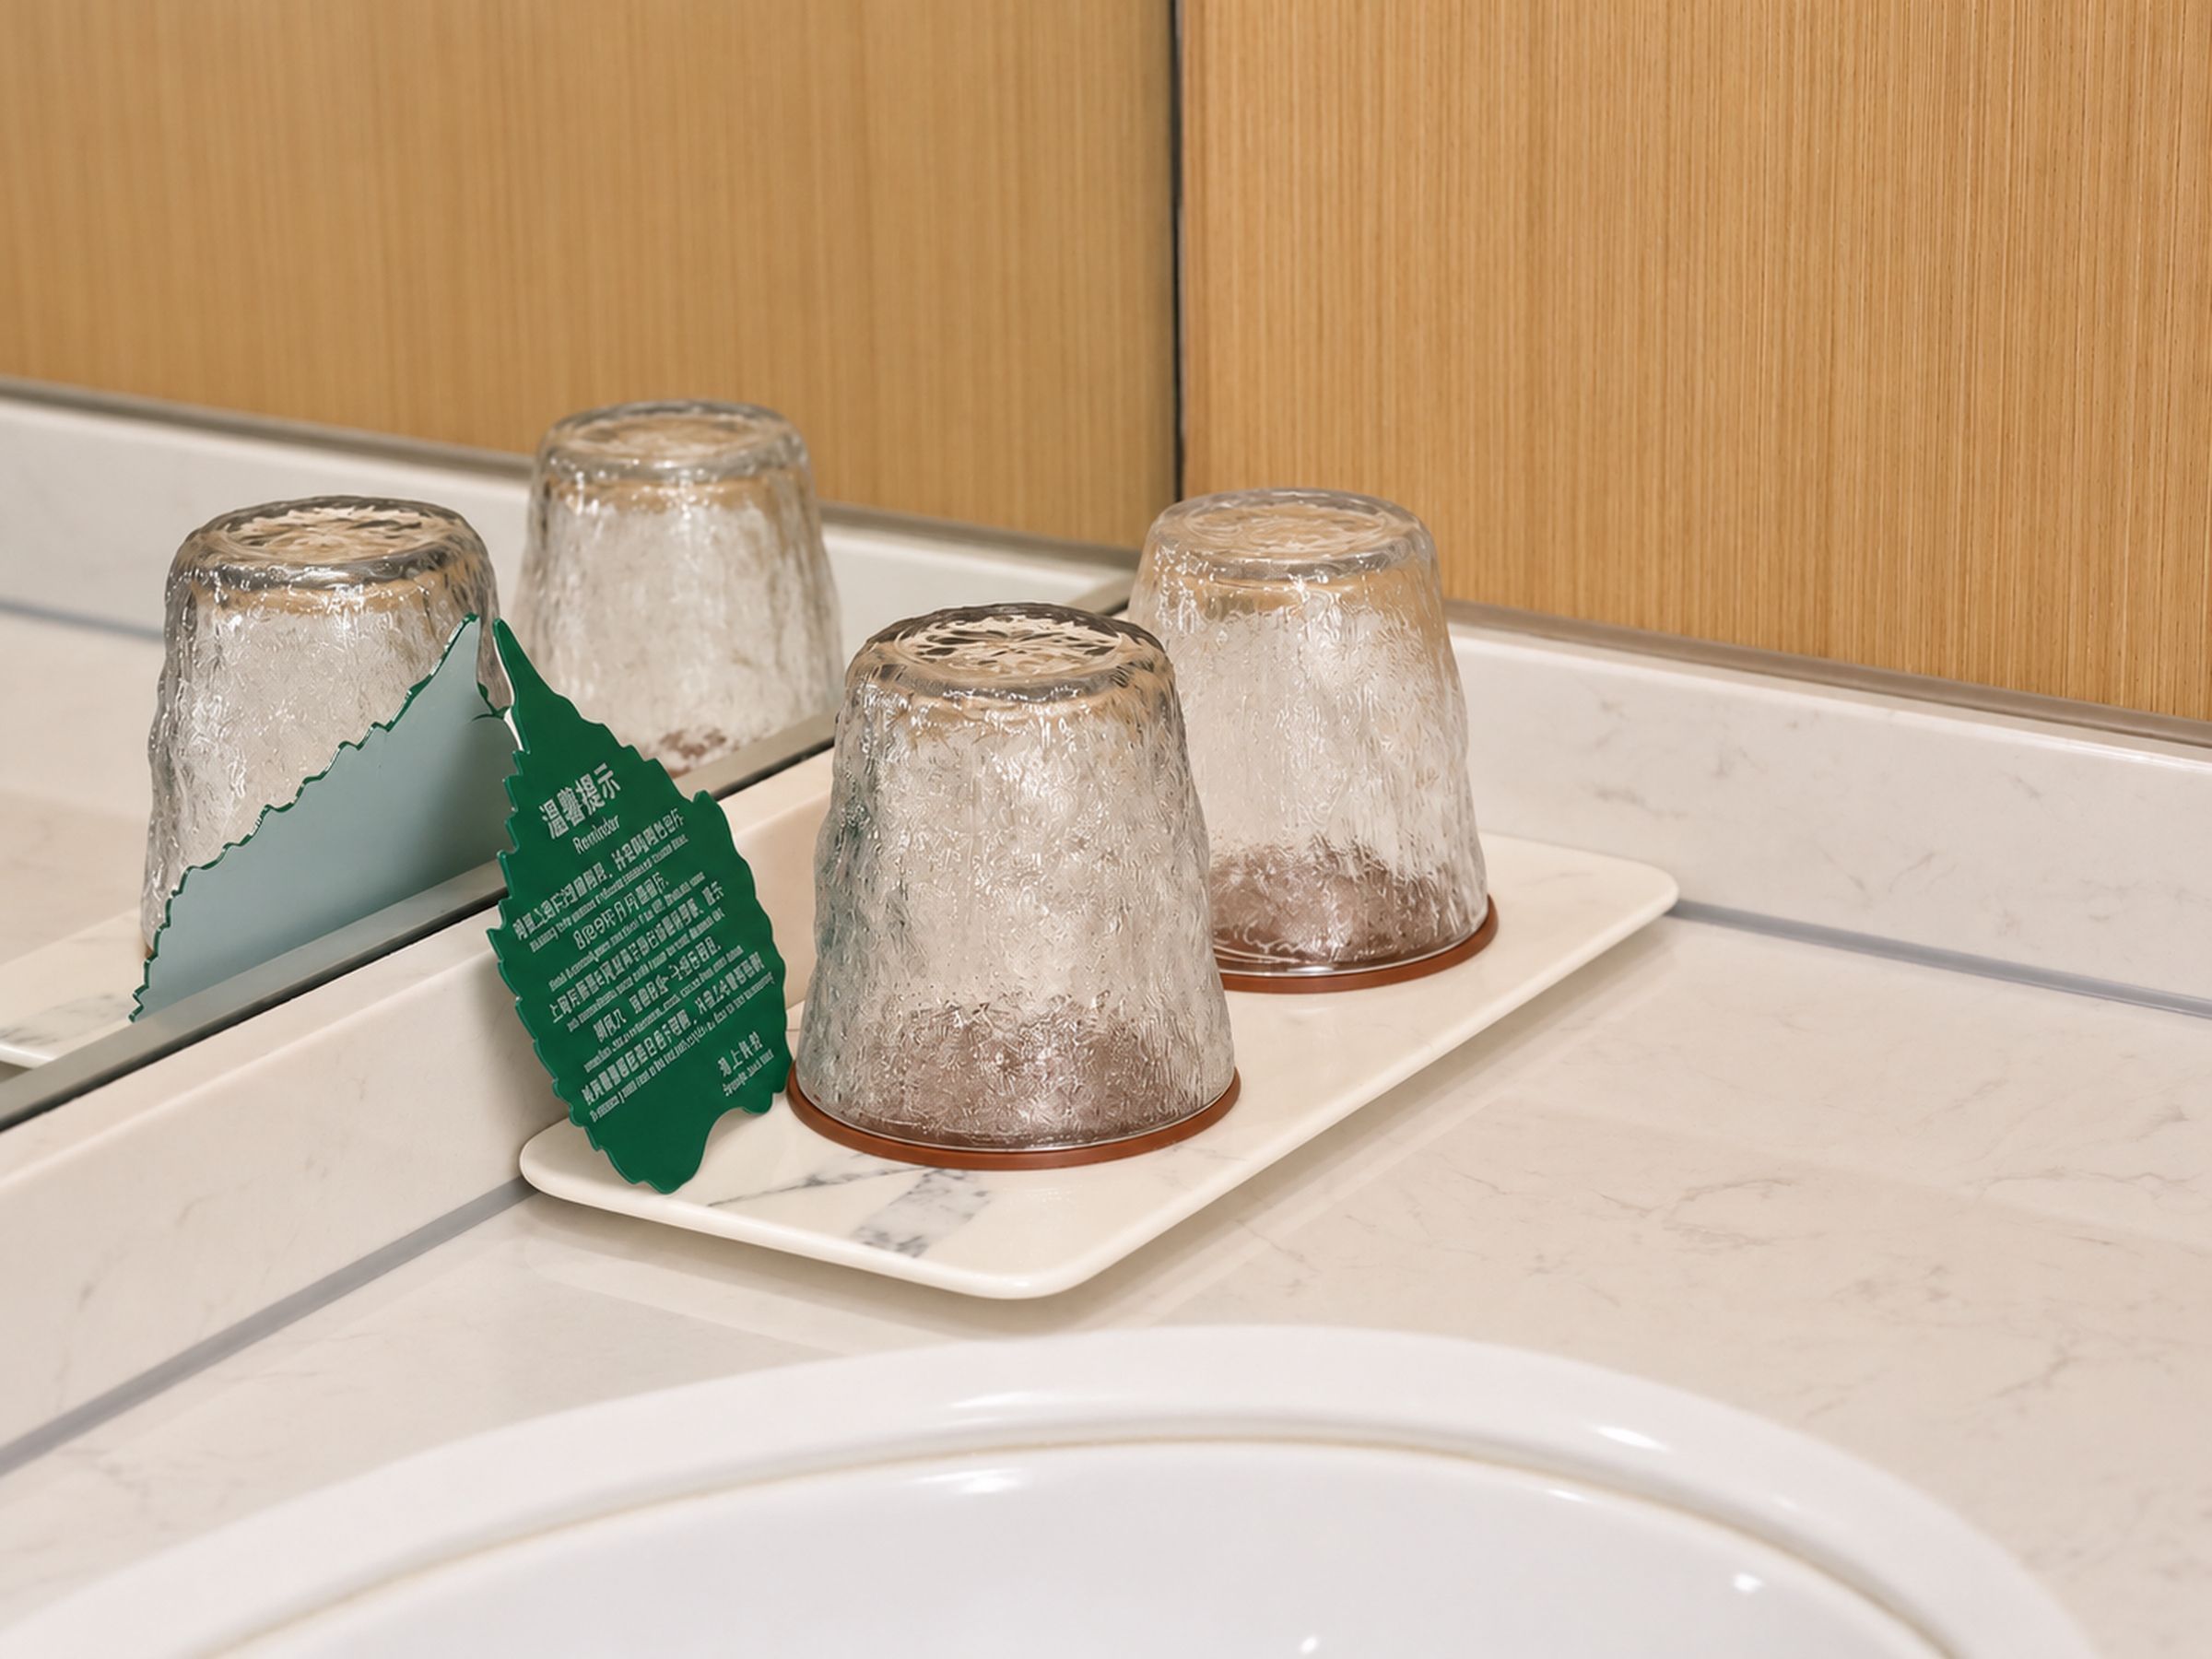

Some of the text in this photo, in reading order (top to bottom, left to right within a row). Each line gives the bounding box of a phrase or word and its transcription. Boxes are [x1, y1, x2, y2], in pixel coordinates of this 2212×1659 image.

[539, 762, 621, 840] 温馨提示
[572, 815, 620, 864] Reminder
